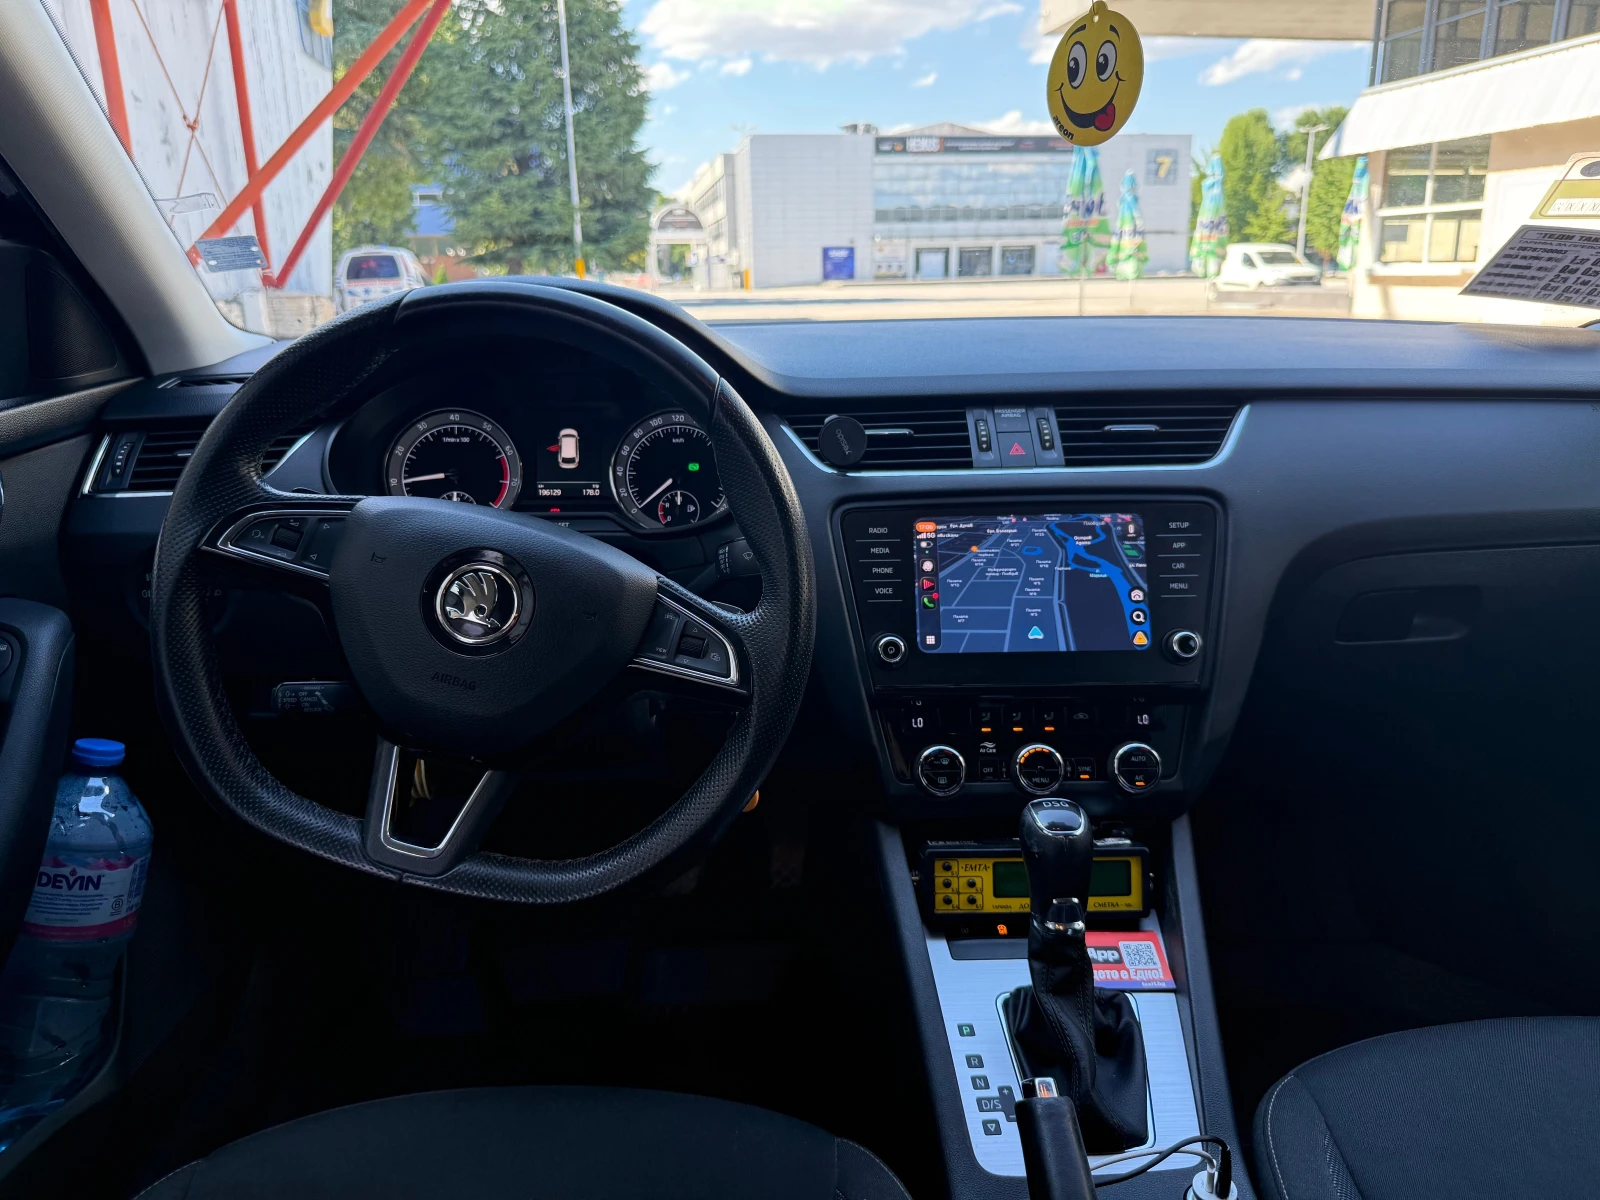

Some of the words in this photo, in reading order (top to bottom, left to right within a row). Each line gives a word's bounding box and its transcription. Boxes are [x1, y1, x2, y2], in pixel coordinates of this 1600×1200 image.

[1053, 115, 1074, 140] areon
[1156, 156, 1172, 179] 7
[416, 422, 427, 430] 30
[482, 422, 492, 430] 50
[650, 418, 663, 427] 100
[633, 428, 643, 438] 80
[396, 446, 404, 456] 20
[505, 446, 513, 456] 60
[621, 445, 630, 455] 60
[616, 466, 624, 476] 40
[391, 478, 398, 486] 10
[511, 478, 517, 486] 70
[619, 487, 627, 497] 20
[432, 672, 477, 690] AIRBAG
[912, 717, 924, 728] LO
[1137, 714, 1149, 725] LO
[37, 871, 102, 891] DEVIN
[1087, 948, 1120, 962] App
[962, 1026, 970, 1035] P
[982, 1100, 1002, 1109] D/S
